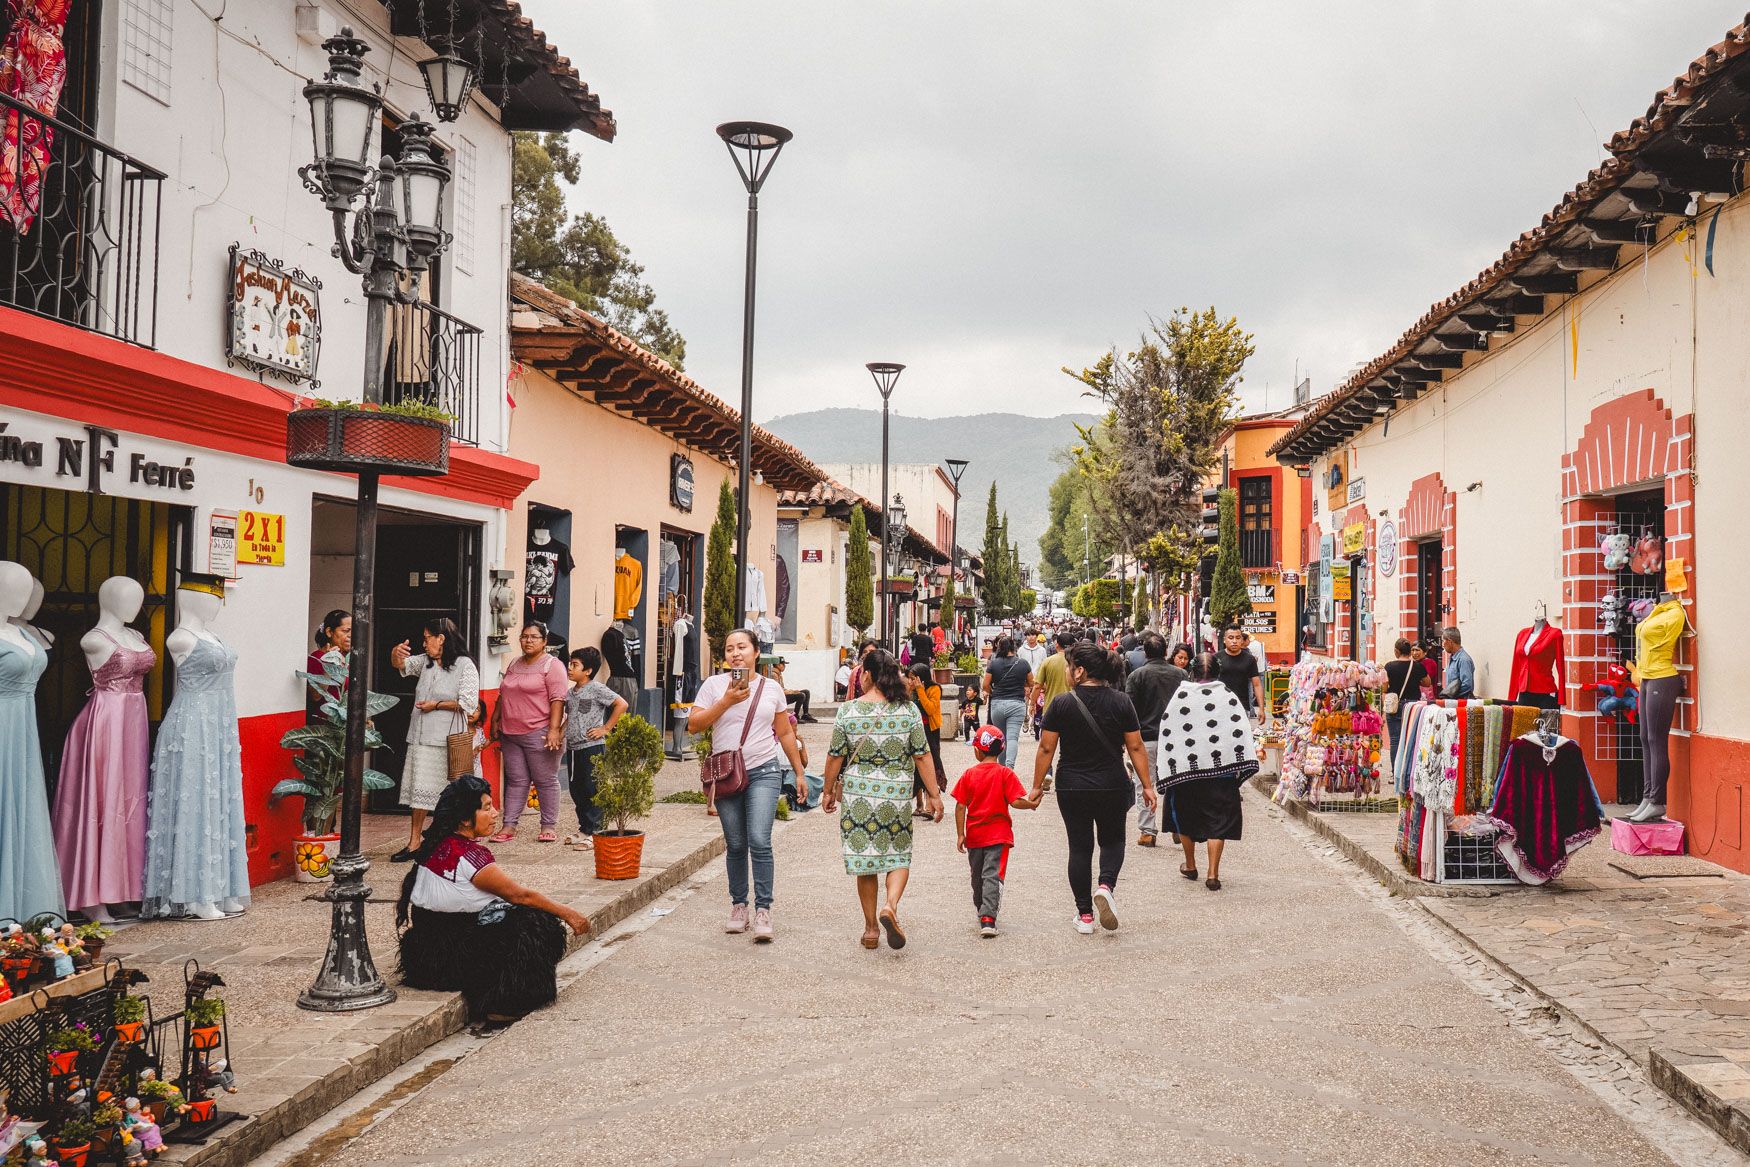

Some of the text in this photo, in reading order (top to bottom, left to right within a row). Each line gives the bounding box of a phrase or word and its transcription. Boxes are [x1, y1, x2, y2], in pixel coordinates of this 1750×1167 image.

[130, 457, 195, 490] Ferré
[243, 511, 255, 541] 2
[275, 515, 282, 543] 1
[251, 543, 276, 553] En Toda la
